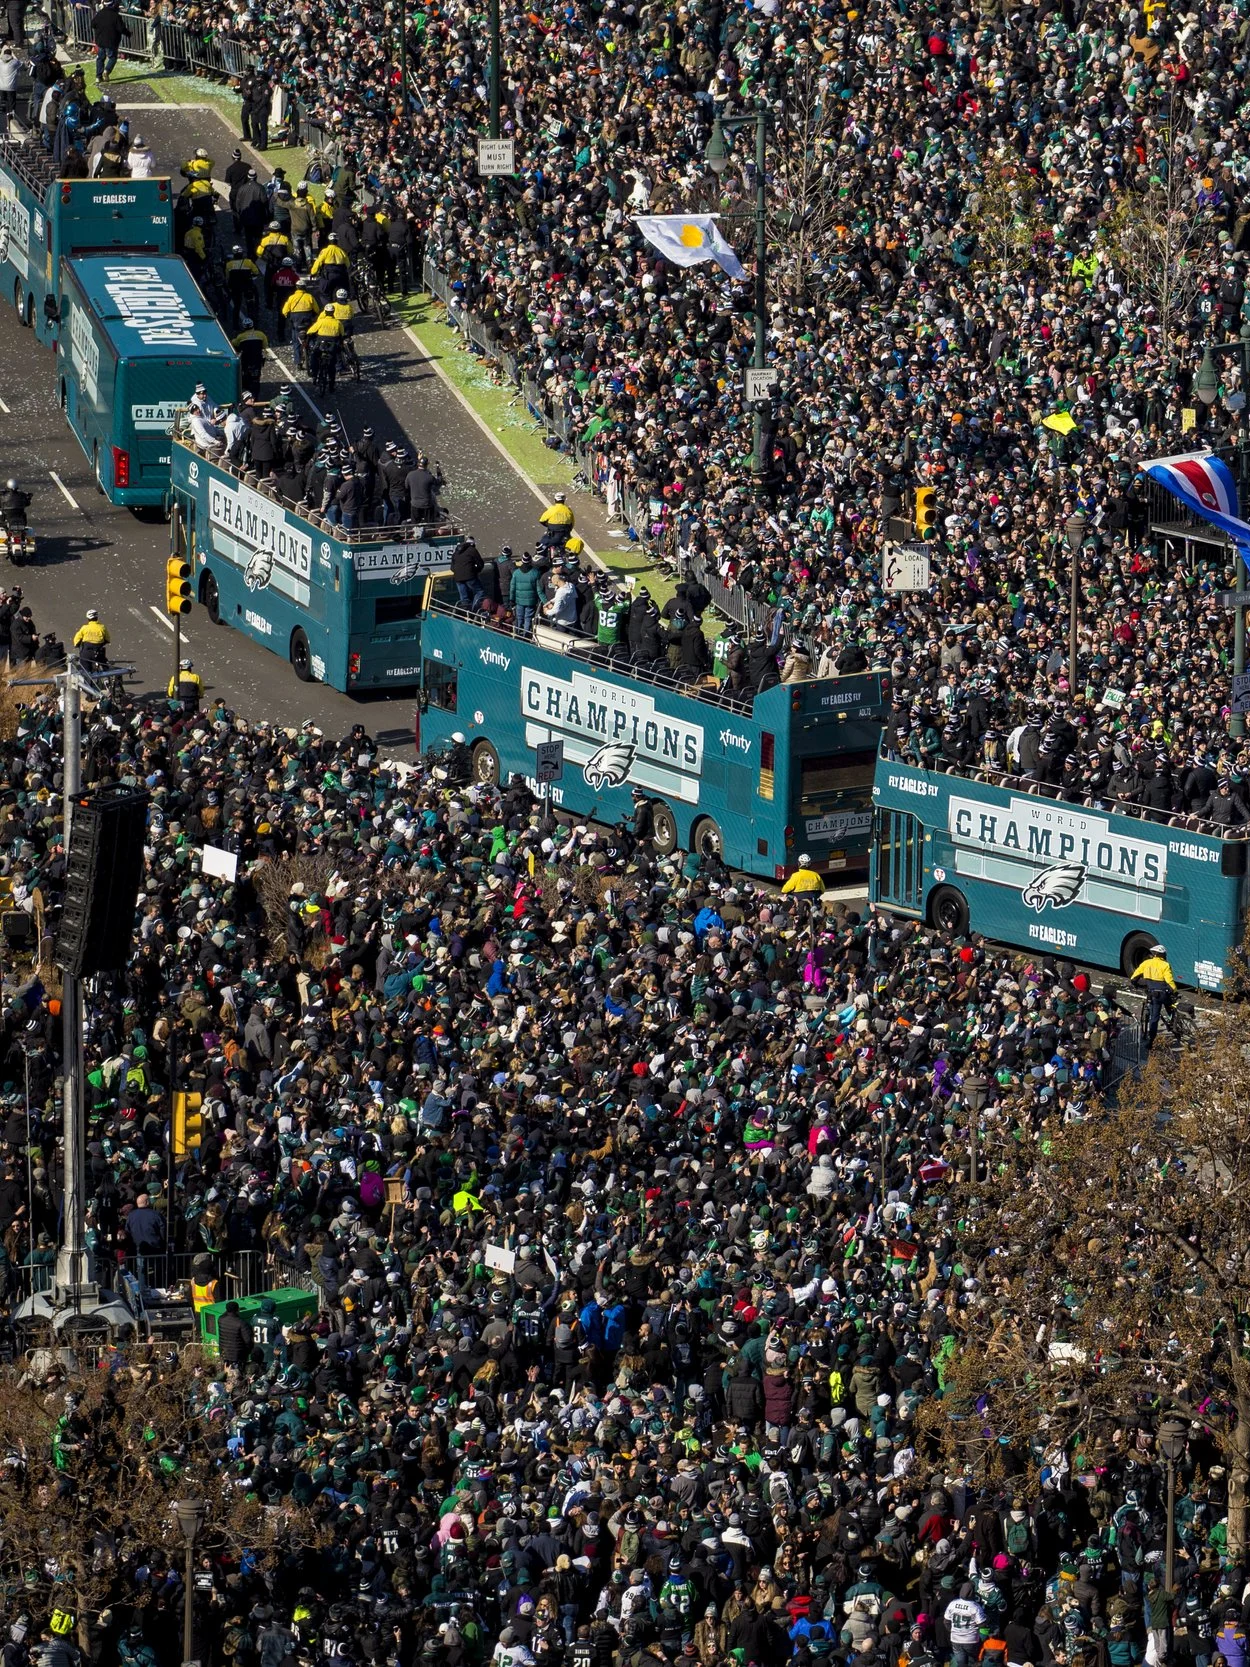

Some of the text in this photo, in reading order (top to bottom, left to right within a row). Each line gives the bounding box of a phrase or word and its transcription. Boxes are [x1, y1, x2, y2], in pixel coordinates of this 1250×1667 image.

[487, 153, 506, 161] MUST
[93, 194, 137, 204] FLY EAGLES FLY
[152, 216, 167, 225] ADL74
[104, 266, 198, 346] FLY EAGLES FLY
[753, 383, 766, 397] N-
[212, 490, 309, 572] CHAMPIONS
[357, 549, 454, 567] CHAMPIONS
[251, 611, 266, 634] EAGLES
[599, 611, 618, 628] 82
[479, 646, 511, 671] xfinity
[393, 667, 413, 676] EAGLES
[589, 684, 637, 708] WORLD
[821, 692, 861, 705] FLY EAGLES FLY
[858, 708, 872, 717] ADL72
[527, 680, 698, 765] CHAMPIONS
[541, 744, 560, 755] STOP
[719, 728, 752, 753] xfinity
[538, 771, 555, 780] RED
[552, 782, 564, 804] FLY
[888, 775, 939, 797] FLY EAGLES FLY
[808, 815, 871, 832] CHAMPIONS
[1031, 809, 1087, 830] WORLD
[956, 808, 1159, 882] CHAMPIONS
[1169, 841, 1220, 863] FLY EAGLES FLY
[1029, 924, 1077, 947] FLY EAGLES FLY
[253, 1326, 269, 1344] 31
[955, 1603, 969, 1611] CELEK
